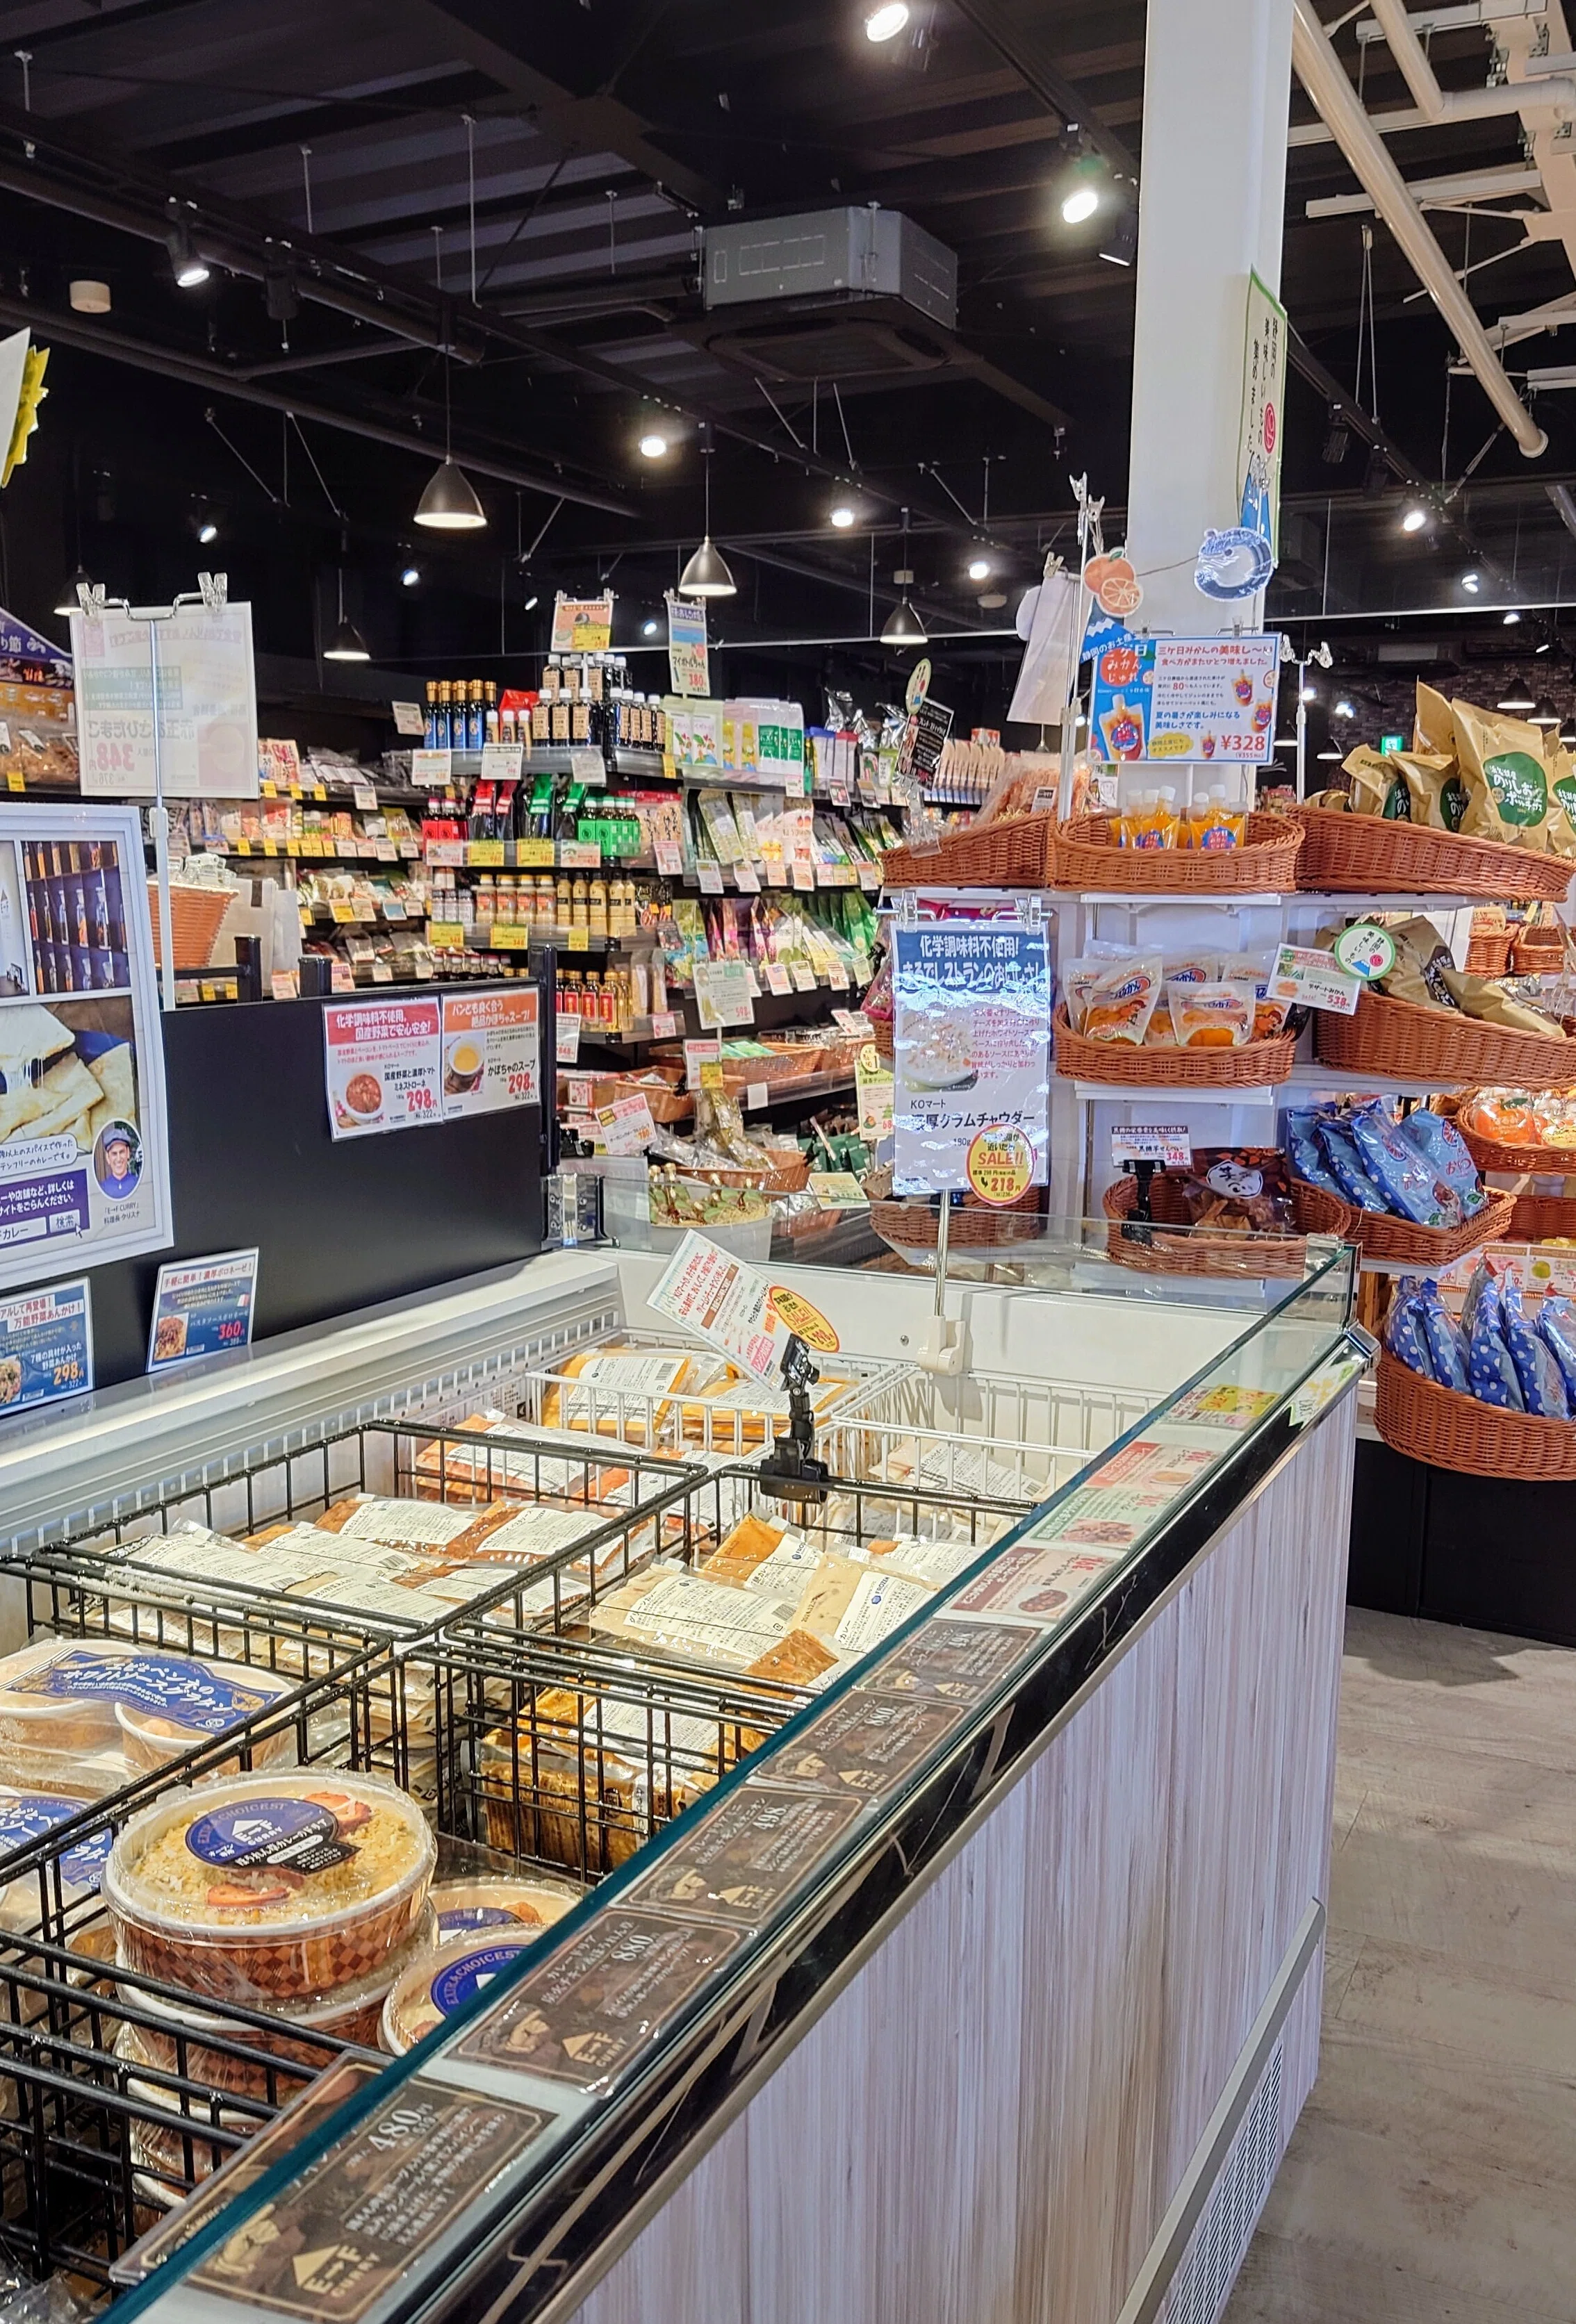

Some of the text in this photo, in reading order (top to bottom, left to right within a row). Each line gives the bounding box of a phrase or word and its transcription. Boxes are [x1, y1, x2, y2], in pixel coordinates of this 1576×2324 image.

[1107, 660, 1142, 671] みかん
[1108, 672, 1138, 683] じゅれ
[1155, 711, 1240, 720] 夏の暑さが楽しみになる
[1155, 720, 1204, 730] 美味しさです。
[1220, 735, 1265, 751] ¥328
[919, 935, 1020, 959] 化学調味料不使用!
[488, 1058, 536, 1077] かぼちゃのスープ
[394, 1079, 427, 1091] ミネストローネ
[56, 1214, 74, 1229] 検索
[0, 1226, 29, 1241] カレー
[247, 1825, 284, 1847] CURRY
[546, 1933, 598, 1980] カレードリア
[596, 2037, 628, 2068] CURRY
[330, 2252, 381, 2299] CURRY
